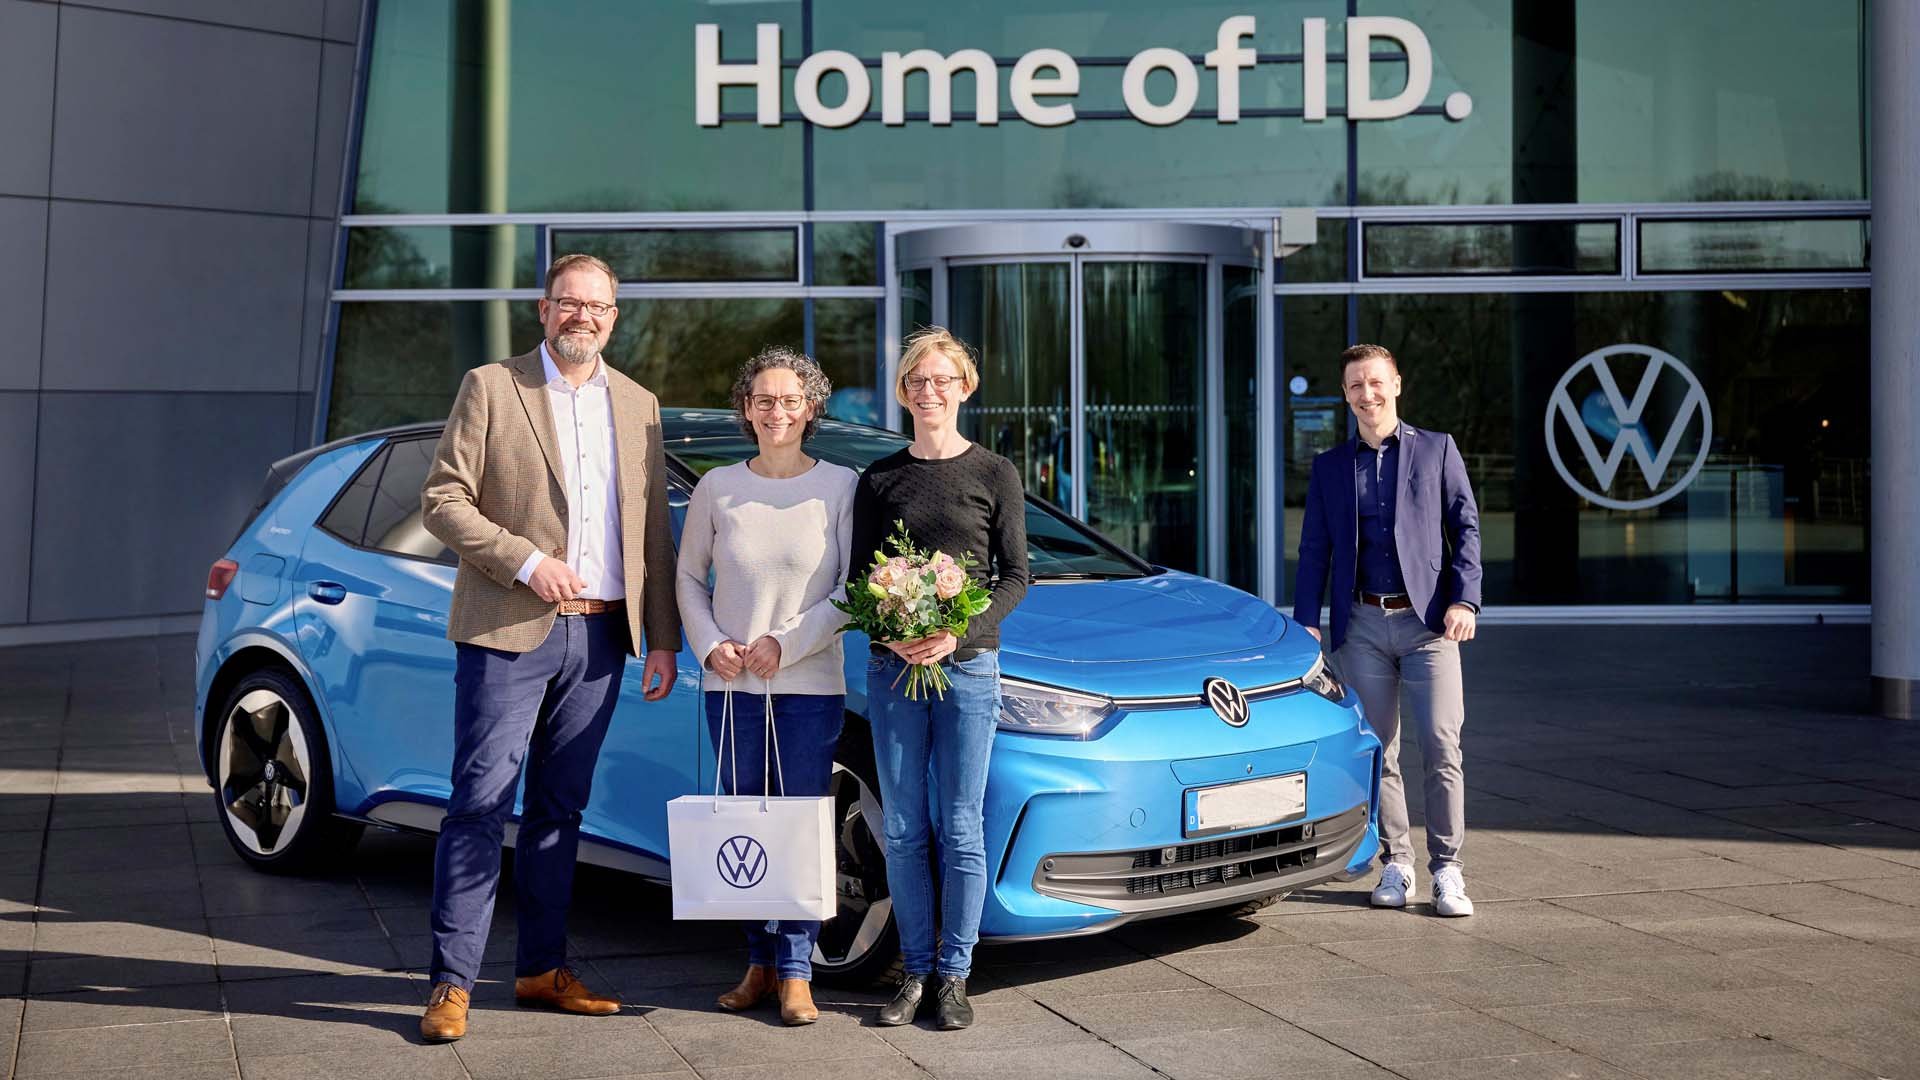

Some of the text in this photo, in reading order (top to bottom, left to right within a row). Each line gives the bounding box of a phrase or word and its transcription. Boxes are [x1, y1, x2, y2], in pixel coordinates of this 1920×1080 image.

[695, 15, 1473, 128] Home of ID.
[1550, 348, 1707, 500] VW
[1209, 680, 1248, 724] VW
[1189, 815, 1196, 825] D
[718, 838, 766, 885] VW
